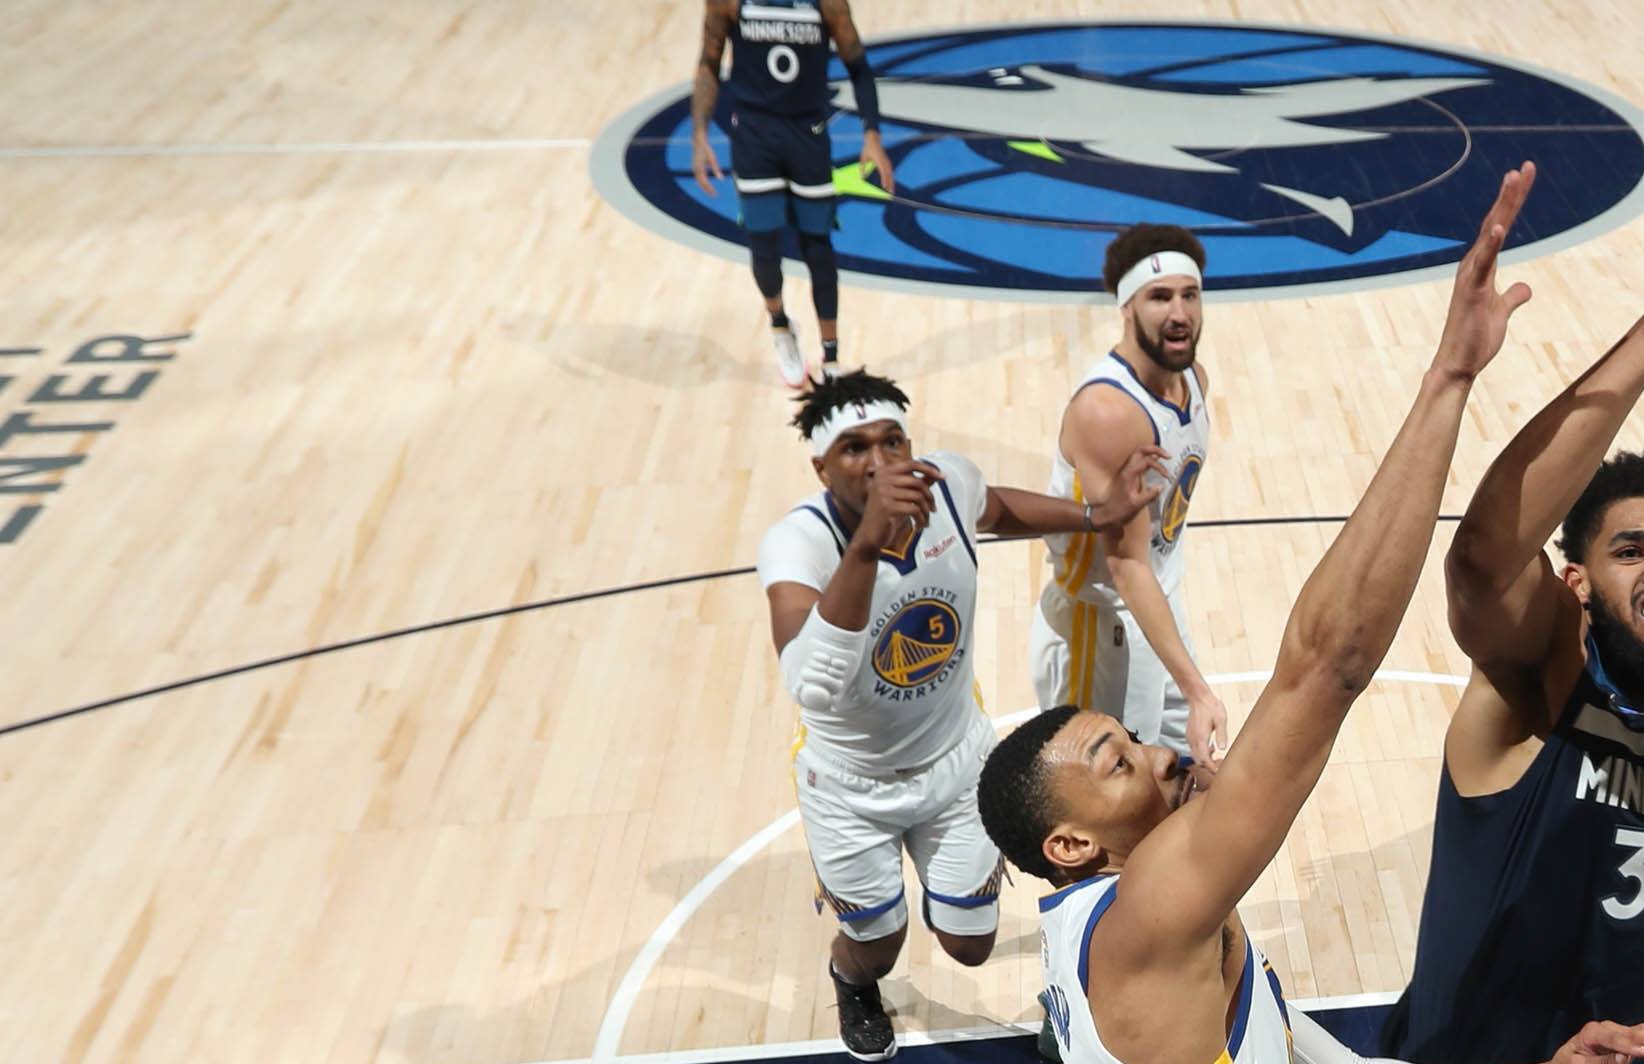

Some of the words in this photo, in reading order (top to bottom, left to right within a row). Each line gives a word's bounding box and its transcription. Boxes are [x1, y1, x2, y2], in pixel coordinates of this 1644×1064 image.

[767, 45, 799, 83] 0
[870, 590, 917, 638] GOLDEN
[922, 586, 958, 604] STATE
[928, 614, 945, 639] 5
